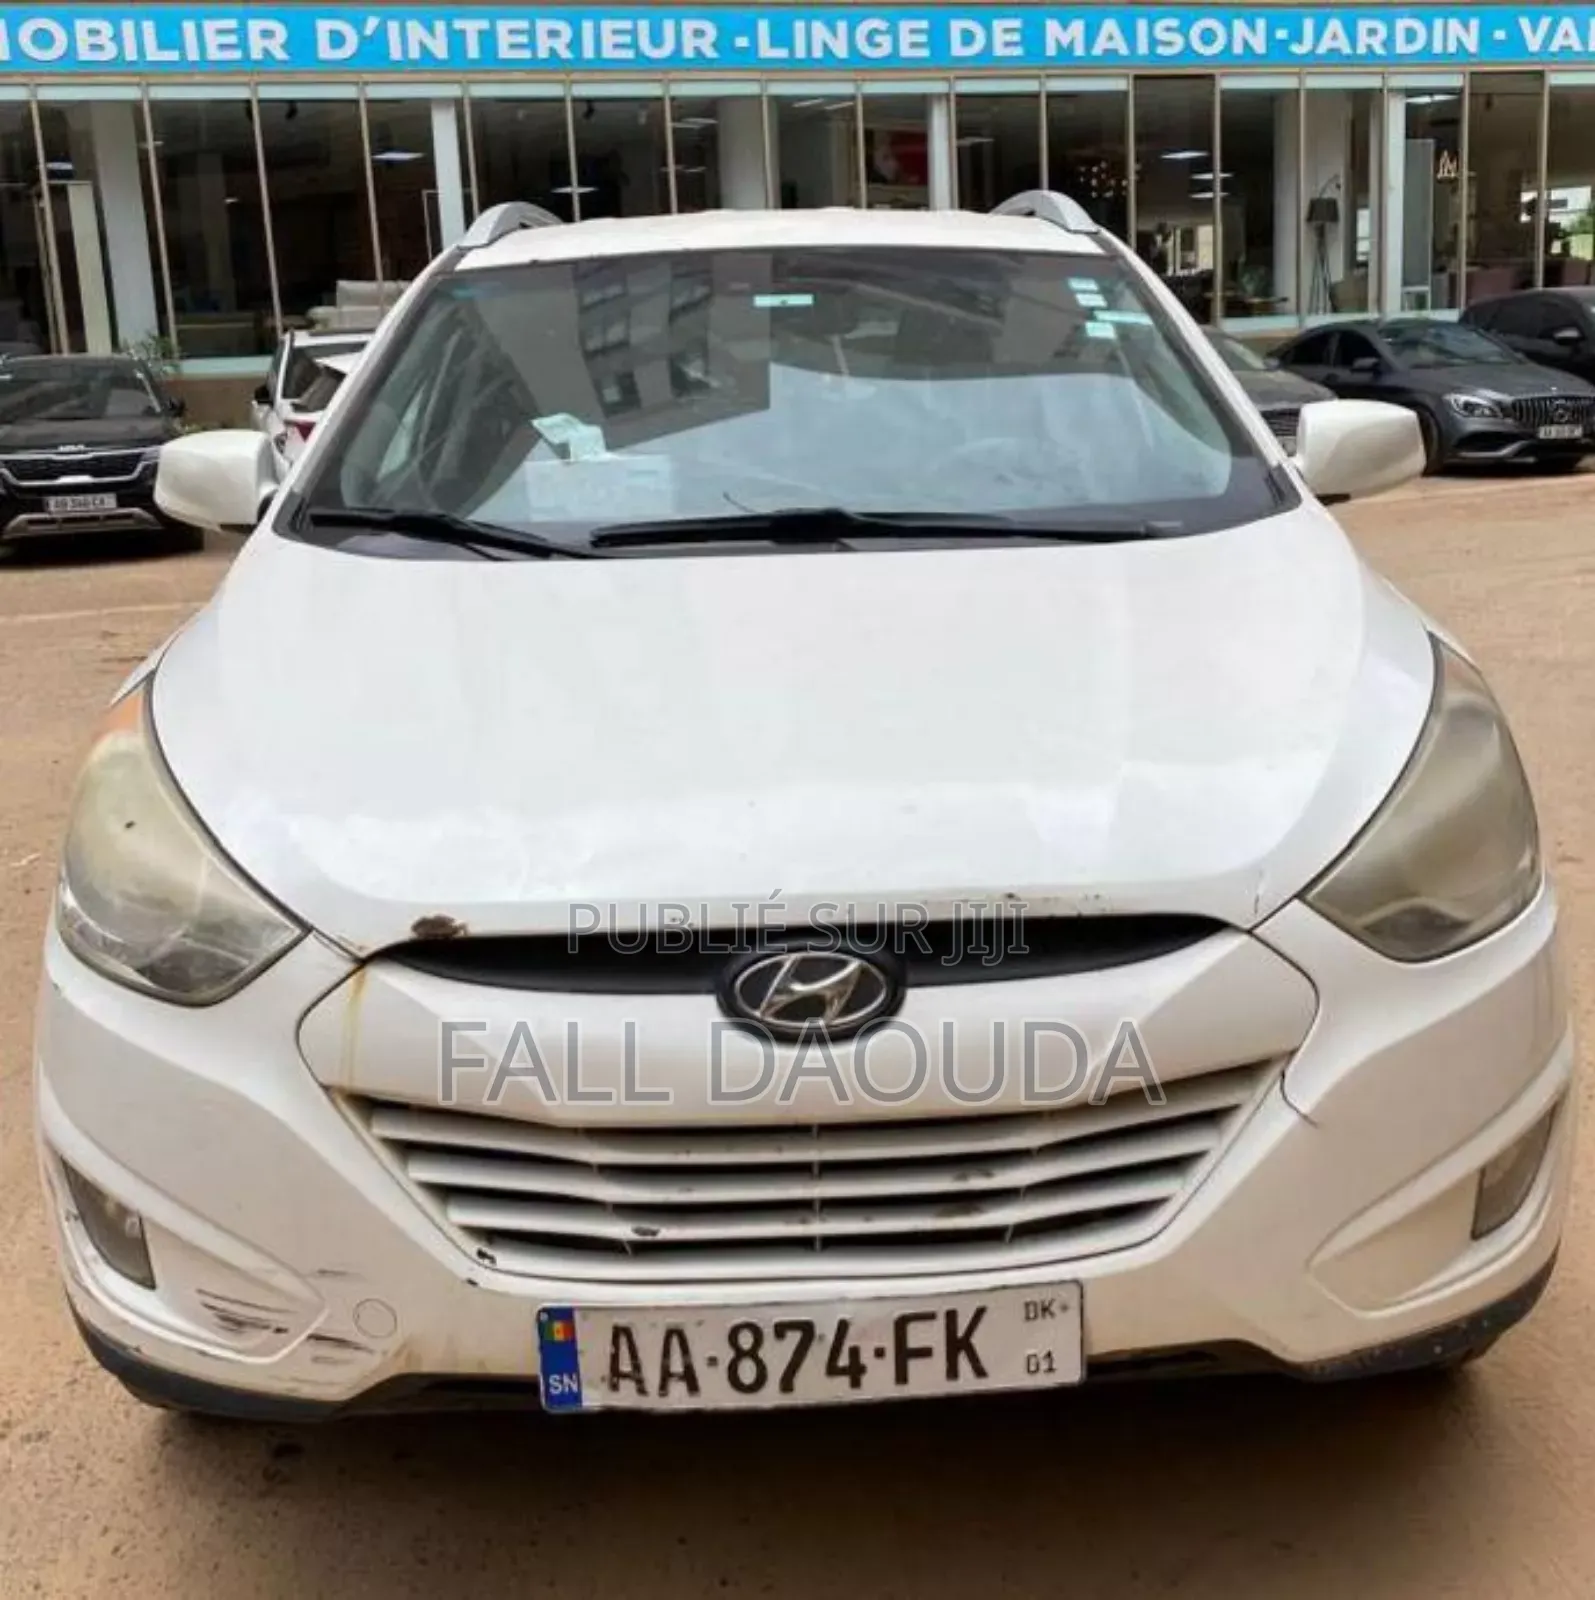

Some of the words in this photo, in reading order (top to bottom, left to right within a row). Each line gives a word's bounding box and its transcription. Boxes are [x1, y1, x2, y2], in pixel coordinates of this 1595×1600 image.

[0, 17, 290, 62] OBILIER
[314, 15, 719, 61] D'INTERIEUR
[949, 17, 1023, 58] DE
[548, 1373, 579, 1396] SN
